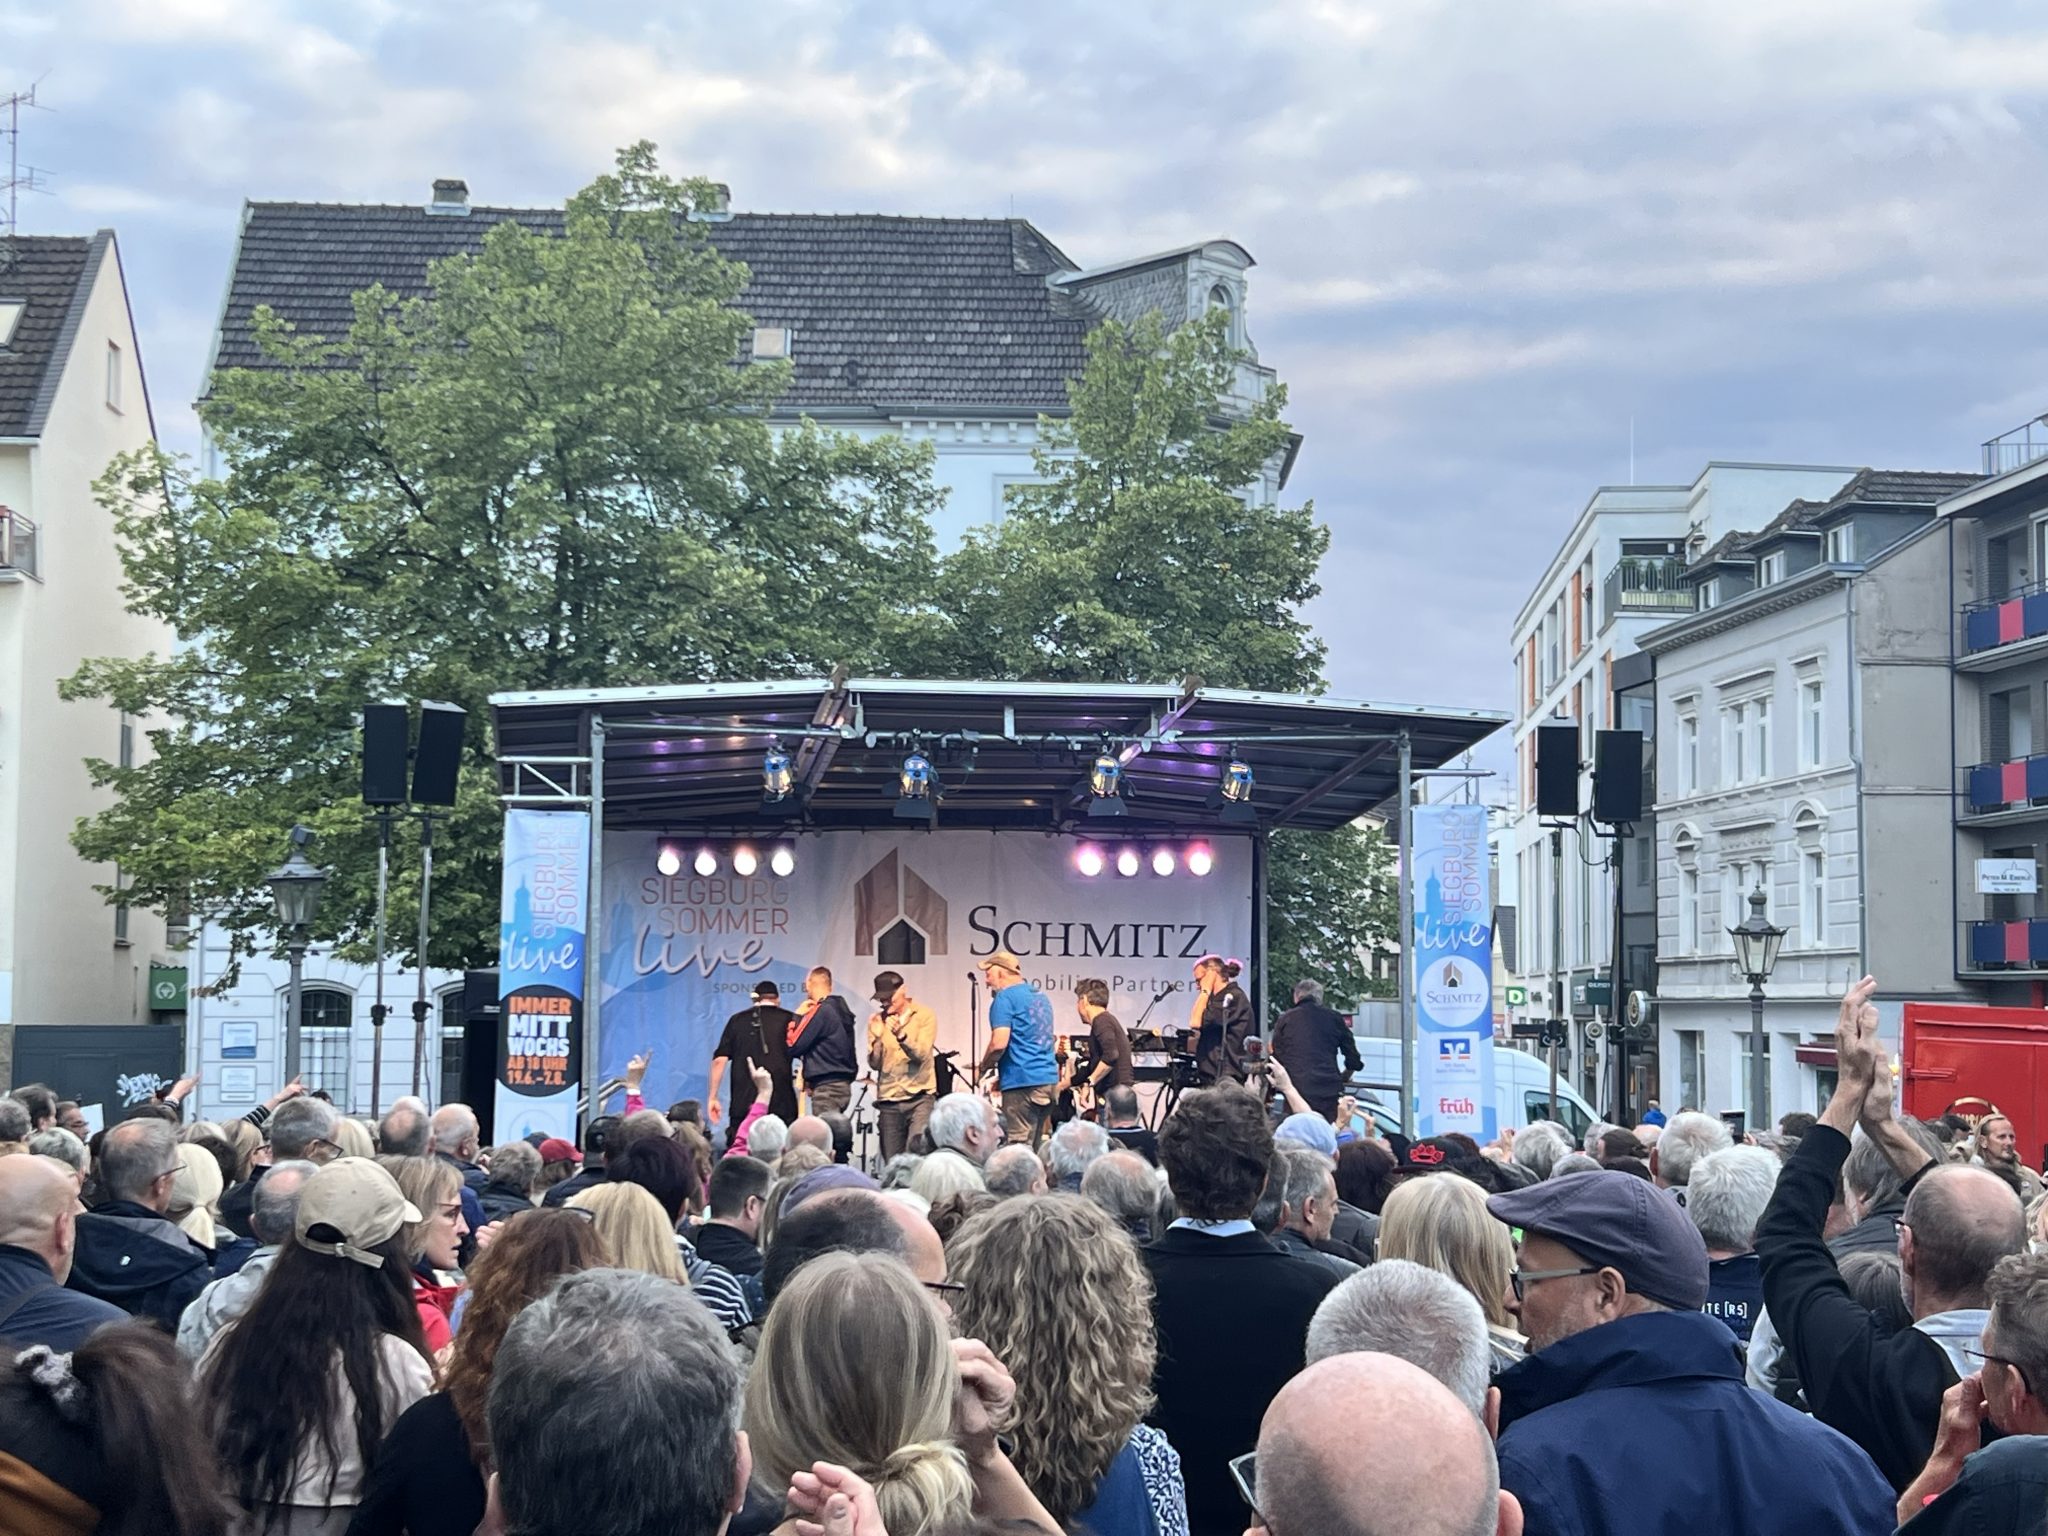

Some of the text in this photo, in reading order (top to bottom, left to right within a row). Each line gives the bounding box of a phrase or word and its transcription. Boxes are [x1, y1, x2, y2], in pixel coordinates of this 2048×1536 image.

[641, 877, 790, 906] SIEGBURG
[658, 907, 790, 935] SOMMER
[1422, 914, 1486, 951] live
[506, 931, 580, 974] live
[634, 923, 774, 979] live
[509, 996, 572, 1014] IMMER
[508, 1014, 572, 1037] MITT
[507, 1037, 570, 1057] WOCHS
